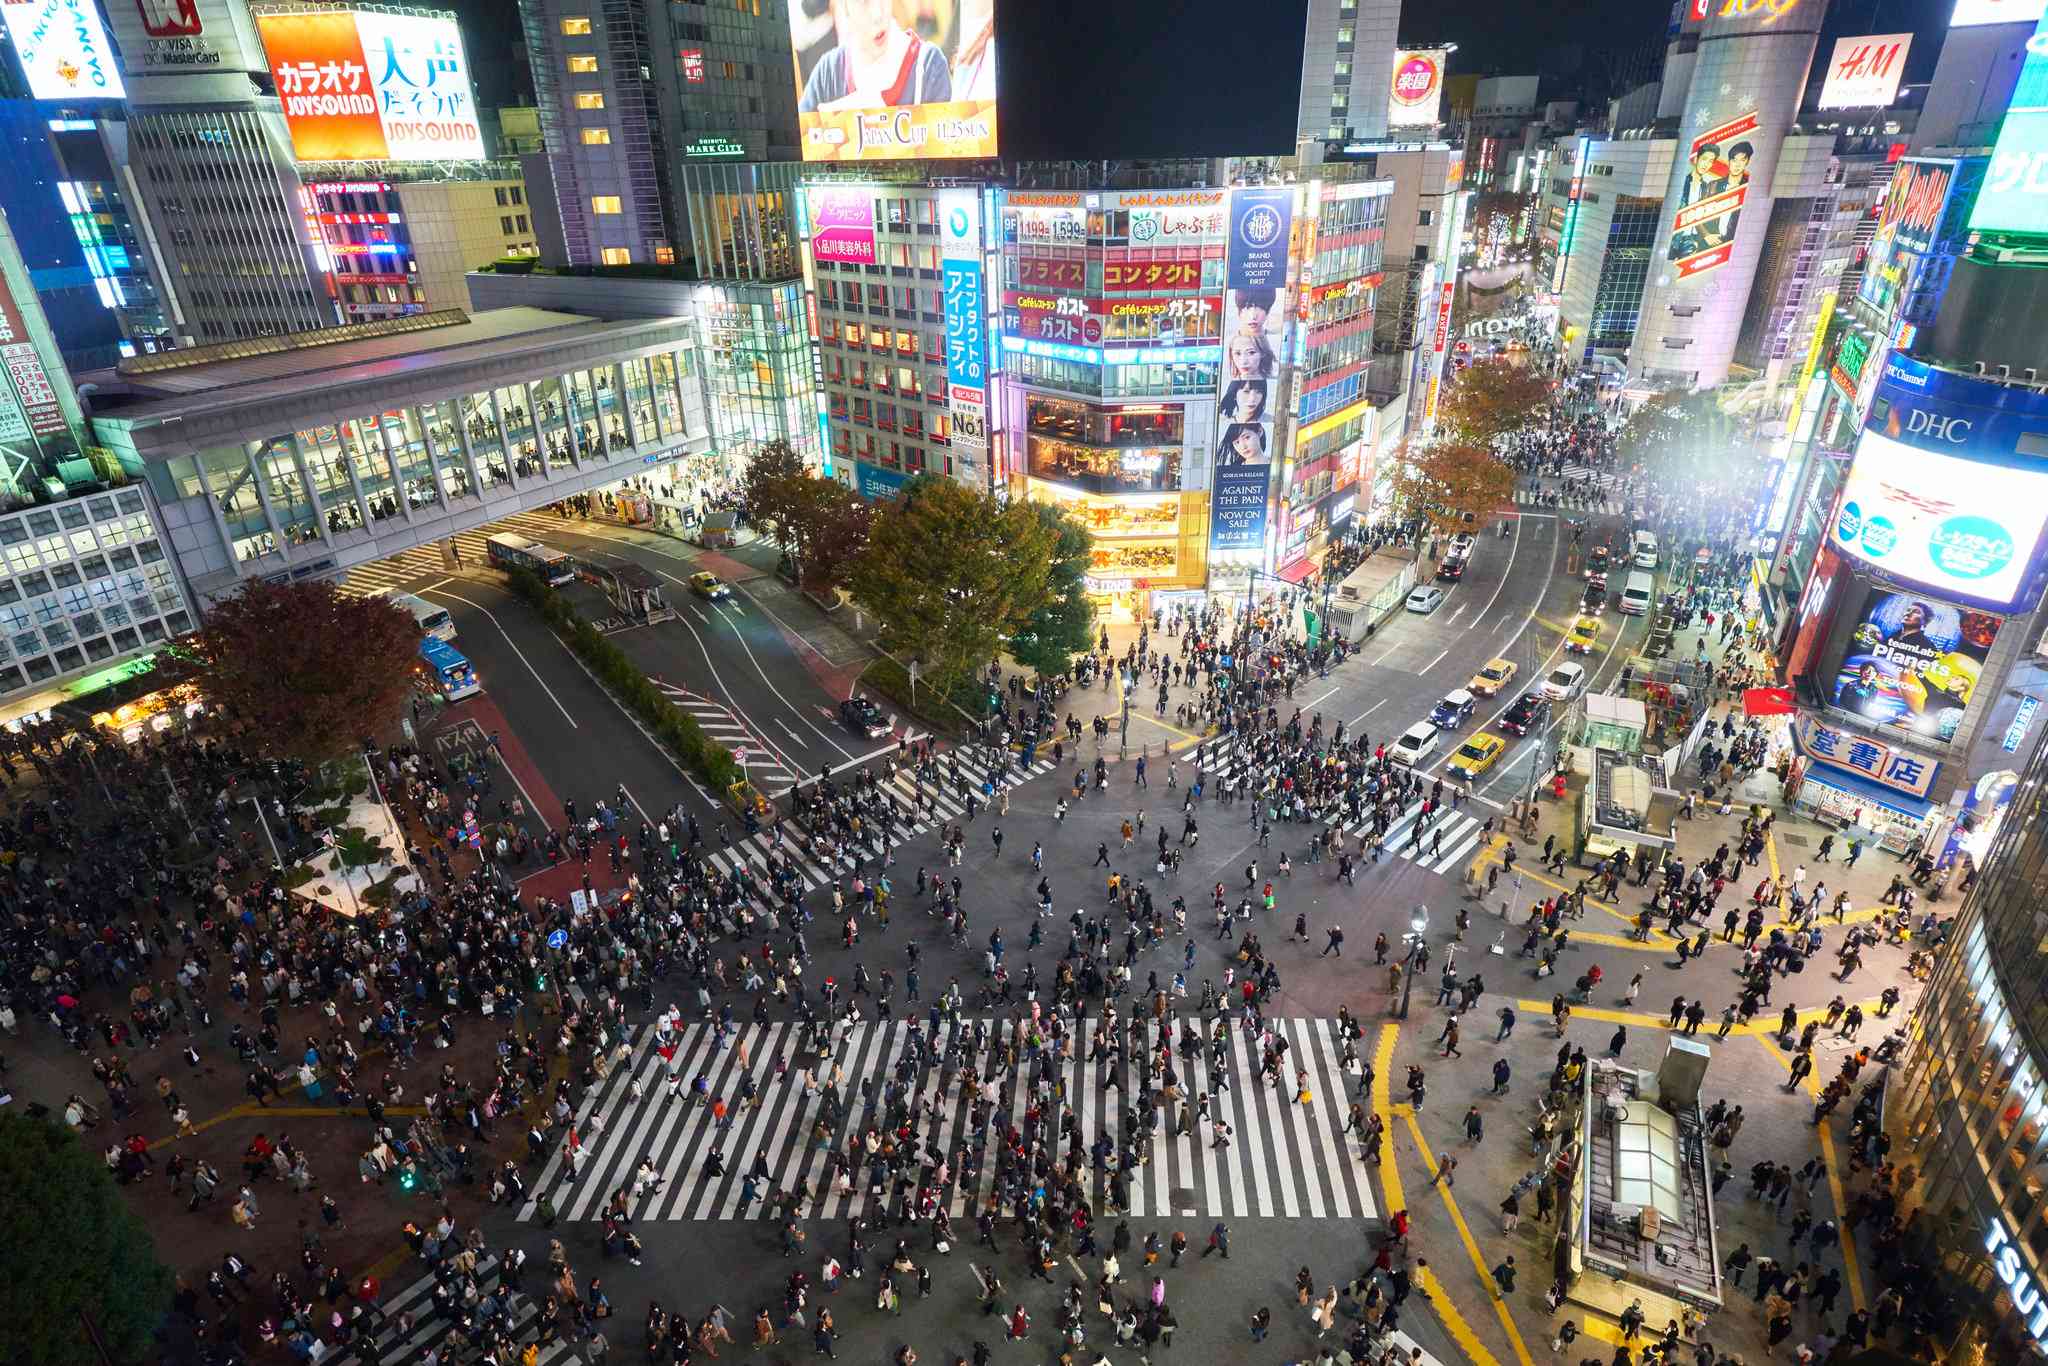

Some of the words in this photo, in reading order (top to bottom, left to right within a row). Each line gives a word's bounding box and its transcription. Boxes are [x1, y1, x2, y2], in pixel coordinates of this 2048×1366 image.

[169, 39, 193, 50] VISA
[163, 52, 220, 64] MasterCard
[1836, 44, 1901, 80] H&M
[277, 61, 364, 93] カラオケ
[287, 94, 375, 116] JOYSOUND
[388, 122, 477, 141] JOYSOUND
[686, 144, 716, 153] MARK
[717, 144, 742, 153] CITY
[1104, 266, 1198, 285] コンタクト
[1056, 297, 1088, 316] ガスト
[1168, 298, 1213, 317] ガスト
[947, 271, 966, 377] アイシティ
[965, 271, 980, 378] コンタクトの
[1040, 317, 1080, 340] ガスト
[952, 412, 985, 438] No.1
[1908, 408, 1973, 444] DHC
[1222, 486, 1263, 495] AGAINST
[1241, 496, 1264, 504] PAIN
[1219, 512, 1244, 520] NOW
[1245, 511, 1260, 519] ON
[1228, 520, 1249, 528] SALE
[1888, 638, 1936, 658] teamLab
[1872, 644, 1951, 676] Planets
